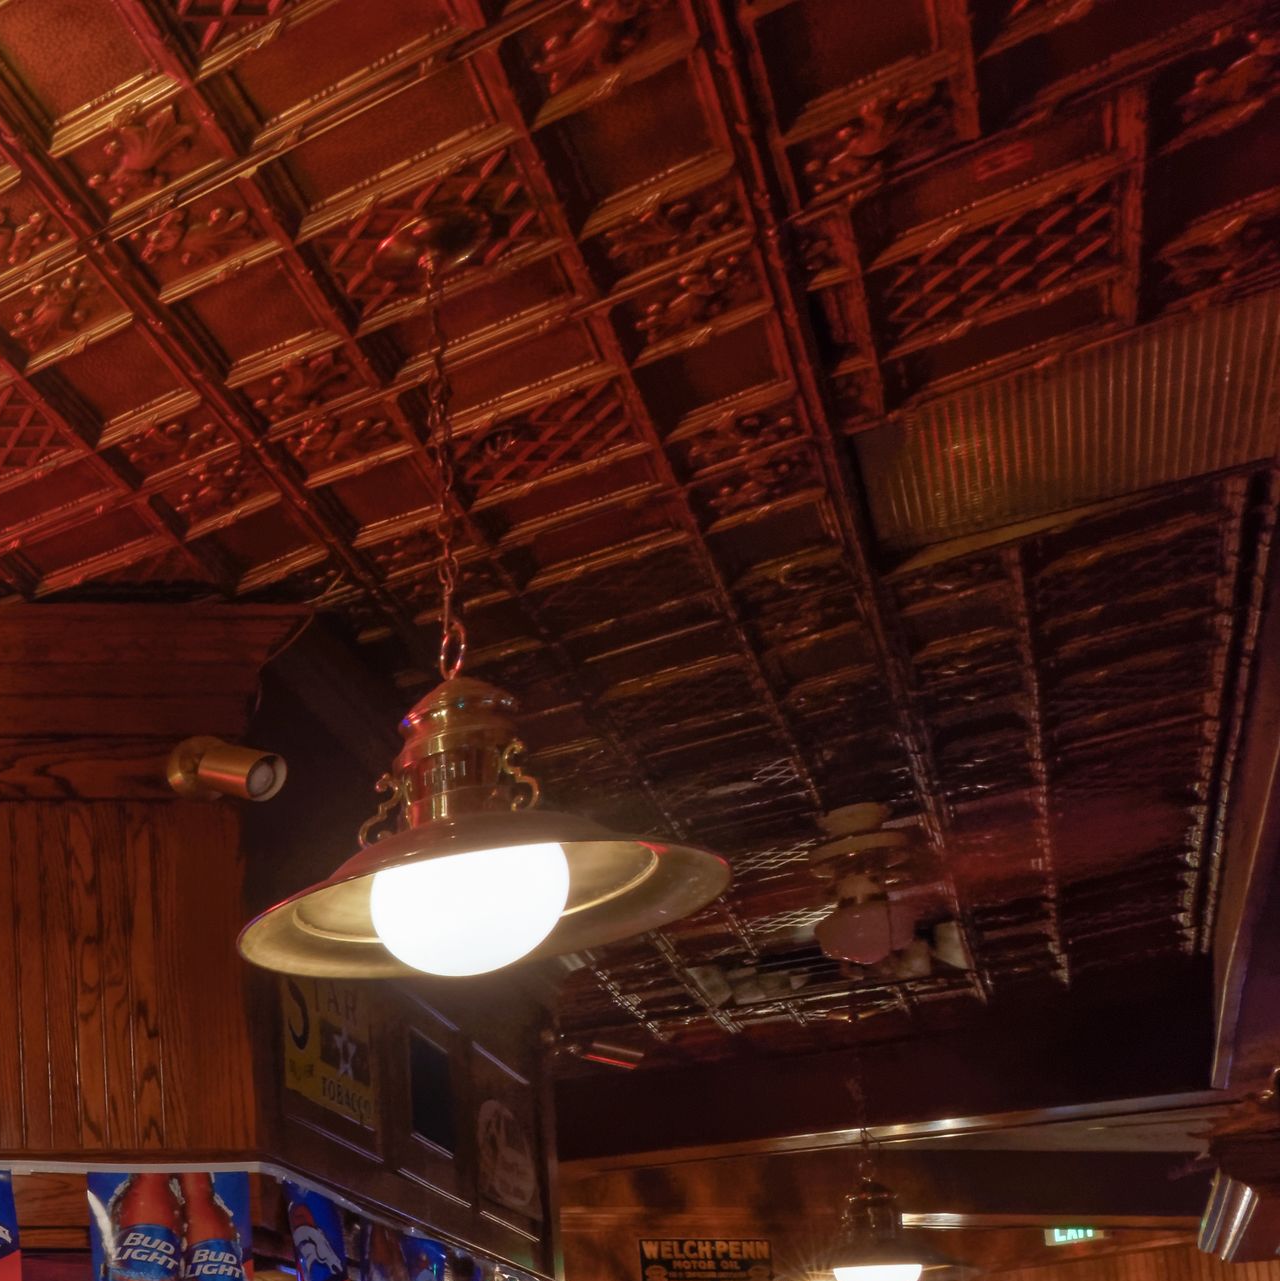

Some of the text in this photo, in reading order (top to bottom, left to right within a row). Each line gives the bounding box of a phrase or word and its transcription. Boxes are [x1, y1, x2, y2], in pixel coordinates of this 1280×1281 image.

[123, 1232, 176, 1256] BUD
[641, 1240, 770, 1260] WELCH-PENN
[112, 1247, 179, 1270] LIGHT
[192, 1249, 238, 1265] BUD
[672, 1260, 717, 1270] MOTOR
[184, 1264, 242, 1279] LIGHT
